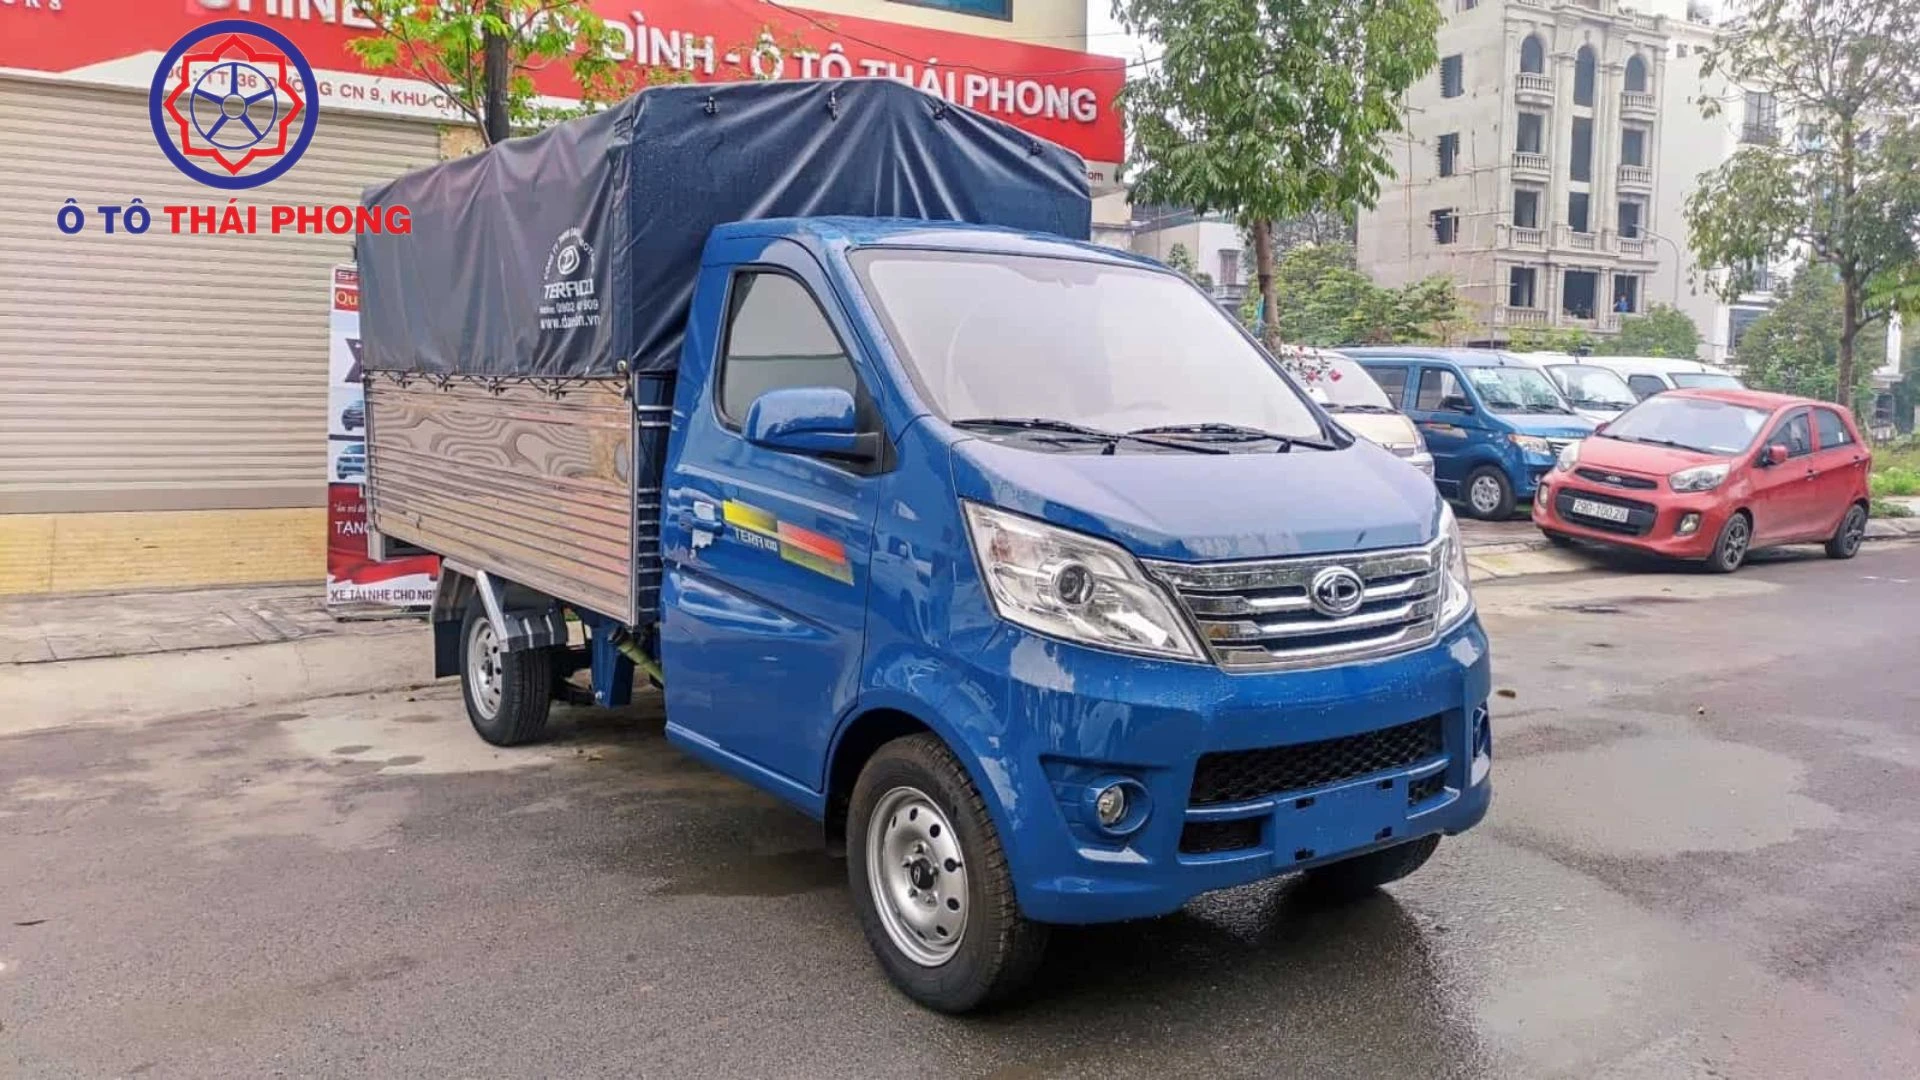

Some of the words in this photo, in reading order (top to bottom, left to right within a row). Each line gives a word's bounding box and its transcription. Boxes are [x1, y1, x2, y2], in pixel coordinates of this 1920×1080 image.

[339, 84, 365, 100] CN
[390, 89, 428, 107] KHU
[751, 32, 784, 80] Ô
[793, 42, 851, 79] TÔ
[964, 73, 1098, 123] PHONG
